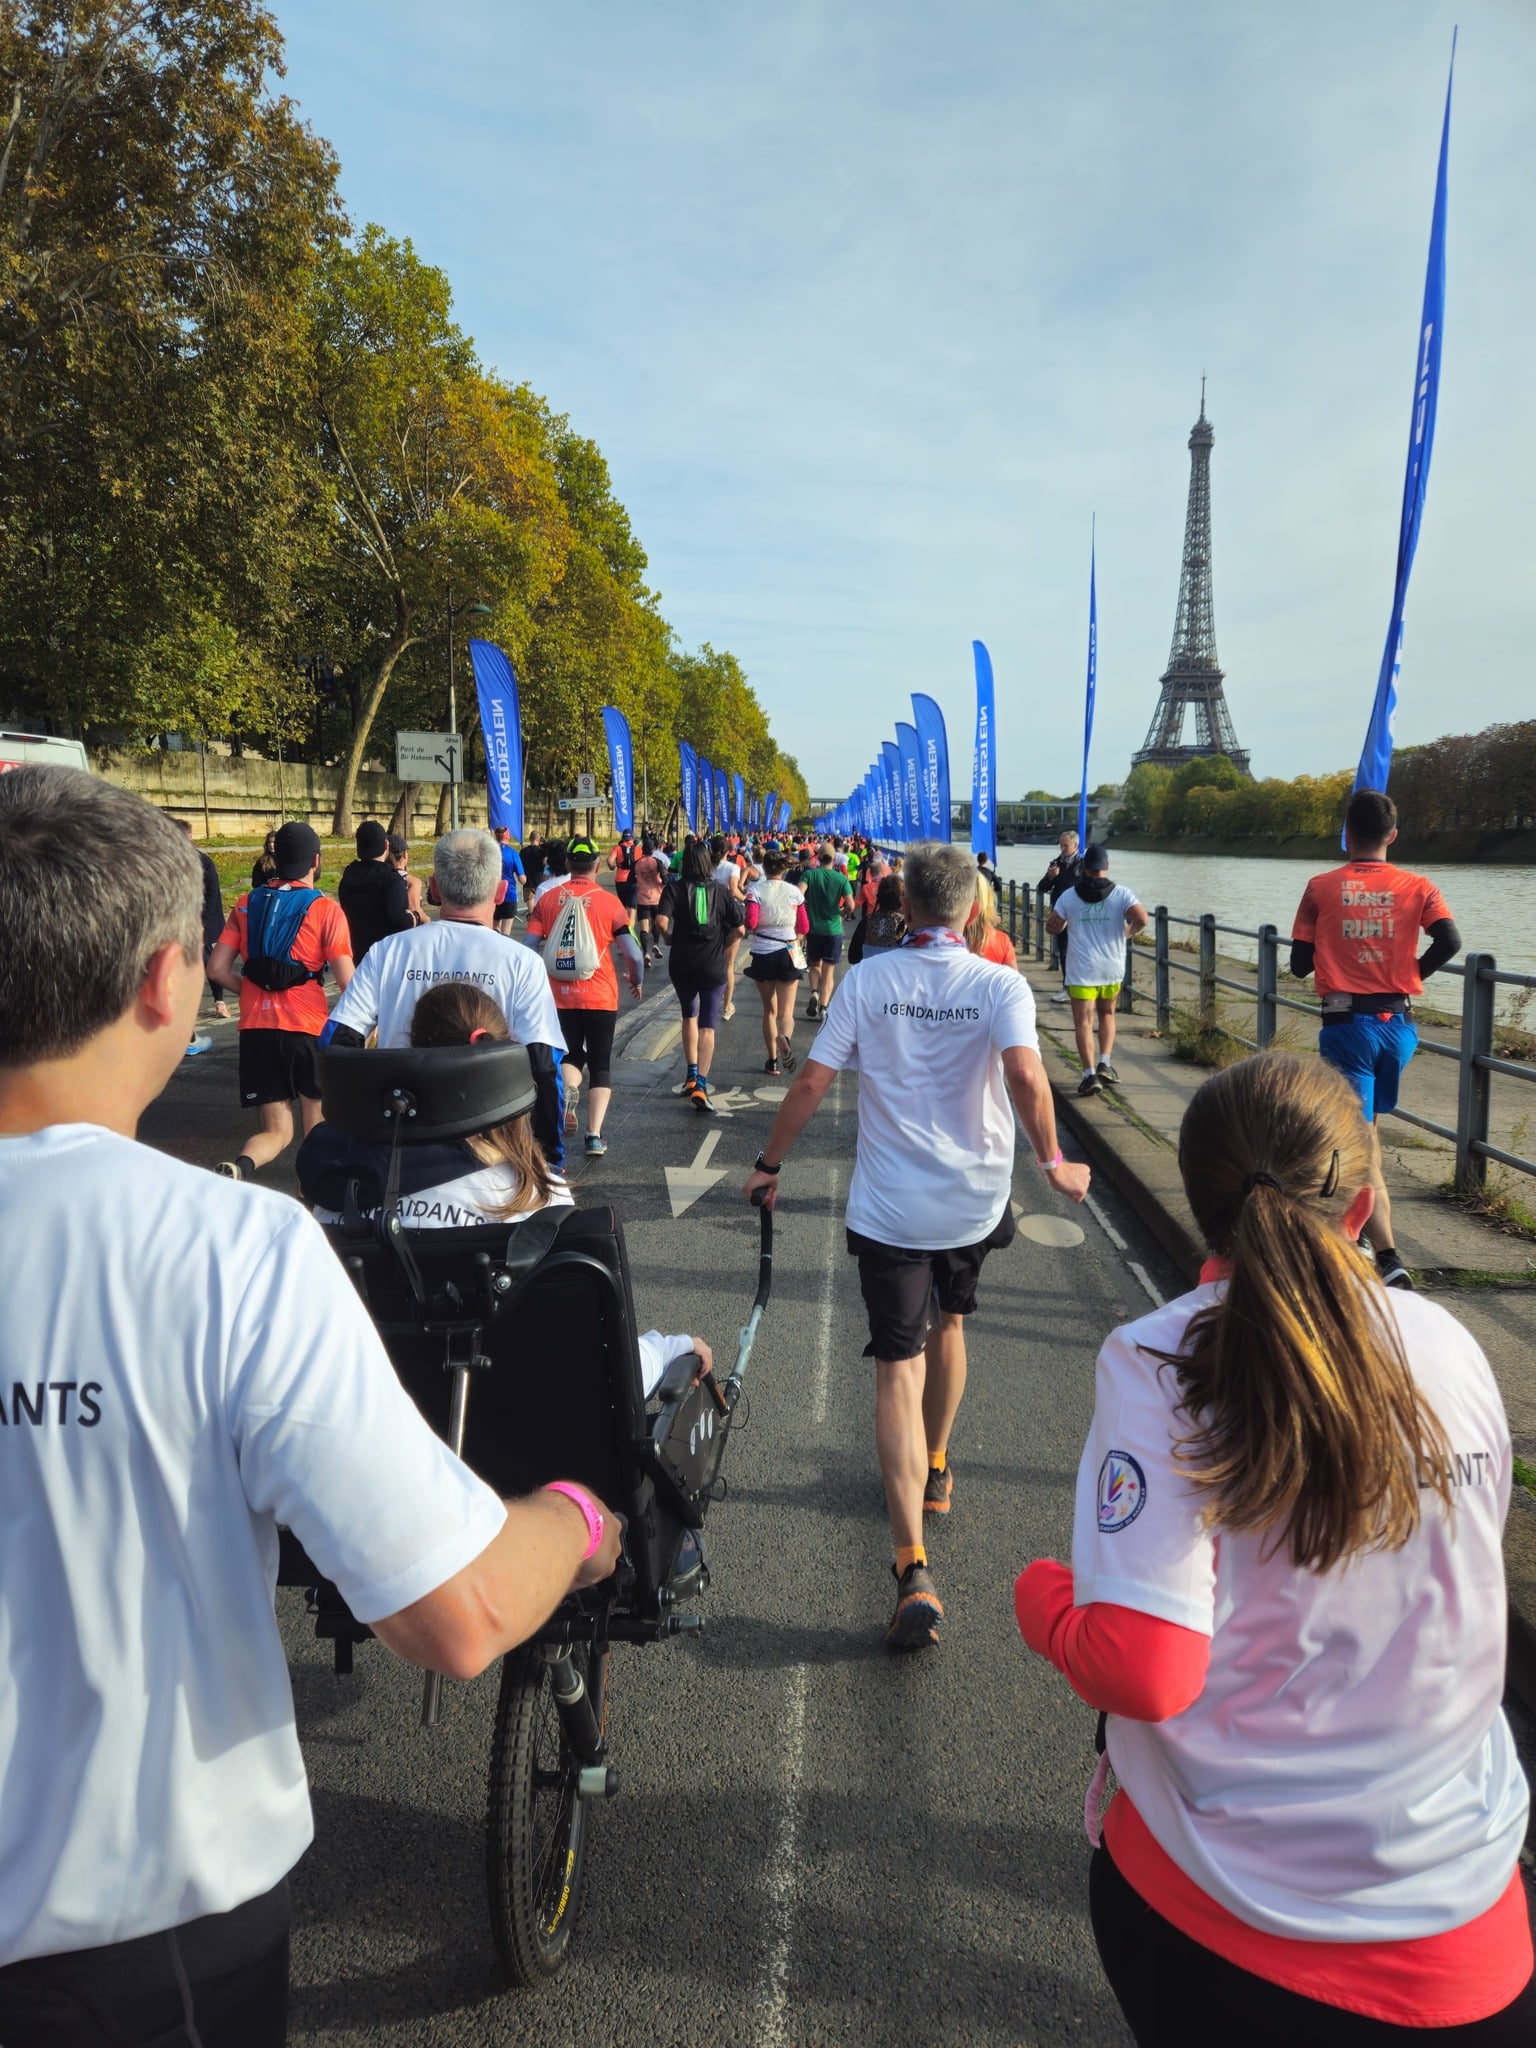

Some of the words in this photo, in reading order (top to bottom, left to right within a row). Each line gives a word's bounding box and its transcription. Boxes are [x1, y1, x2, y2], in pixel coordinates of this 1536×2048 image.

[1342, 891, 1394, 907] DANCE
[557, 960, 574, 969] GMF
[558, 1885, 571, 1917] JUMBO
